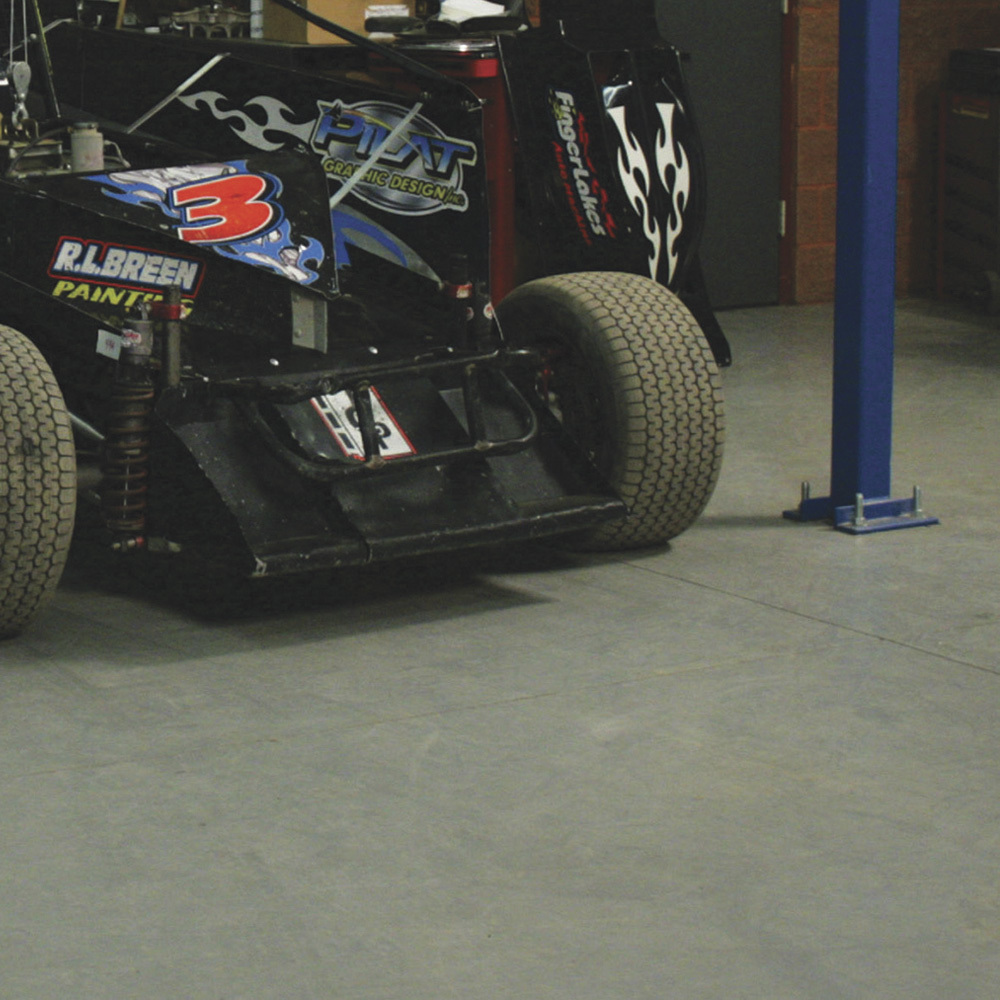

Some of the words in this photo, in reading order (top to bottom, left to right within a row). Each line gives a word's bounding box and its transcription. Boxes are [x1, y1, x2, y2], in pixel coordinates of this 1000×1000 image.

[323, 159, 388, 186] GRAHIC
[173, 173, 274, 244] 3
[52, 280, 194, 318] PAINT
